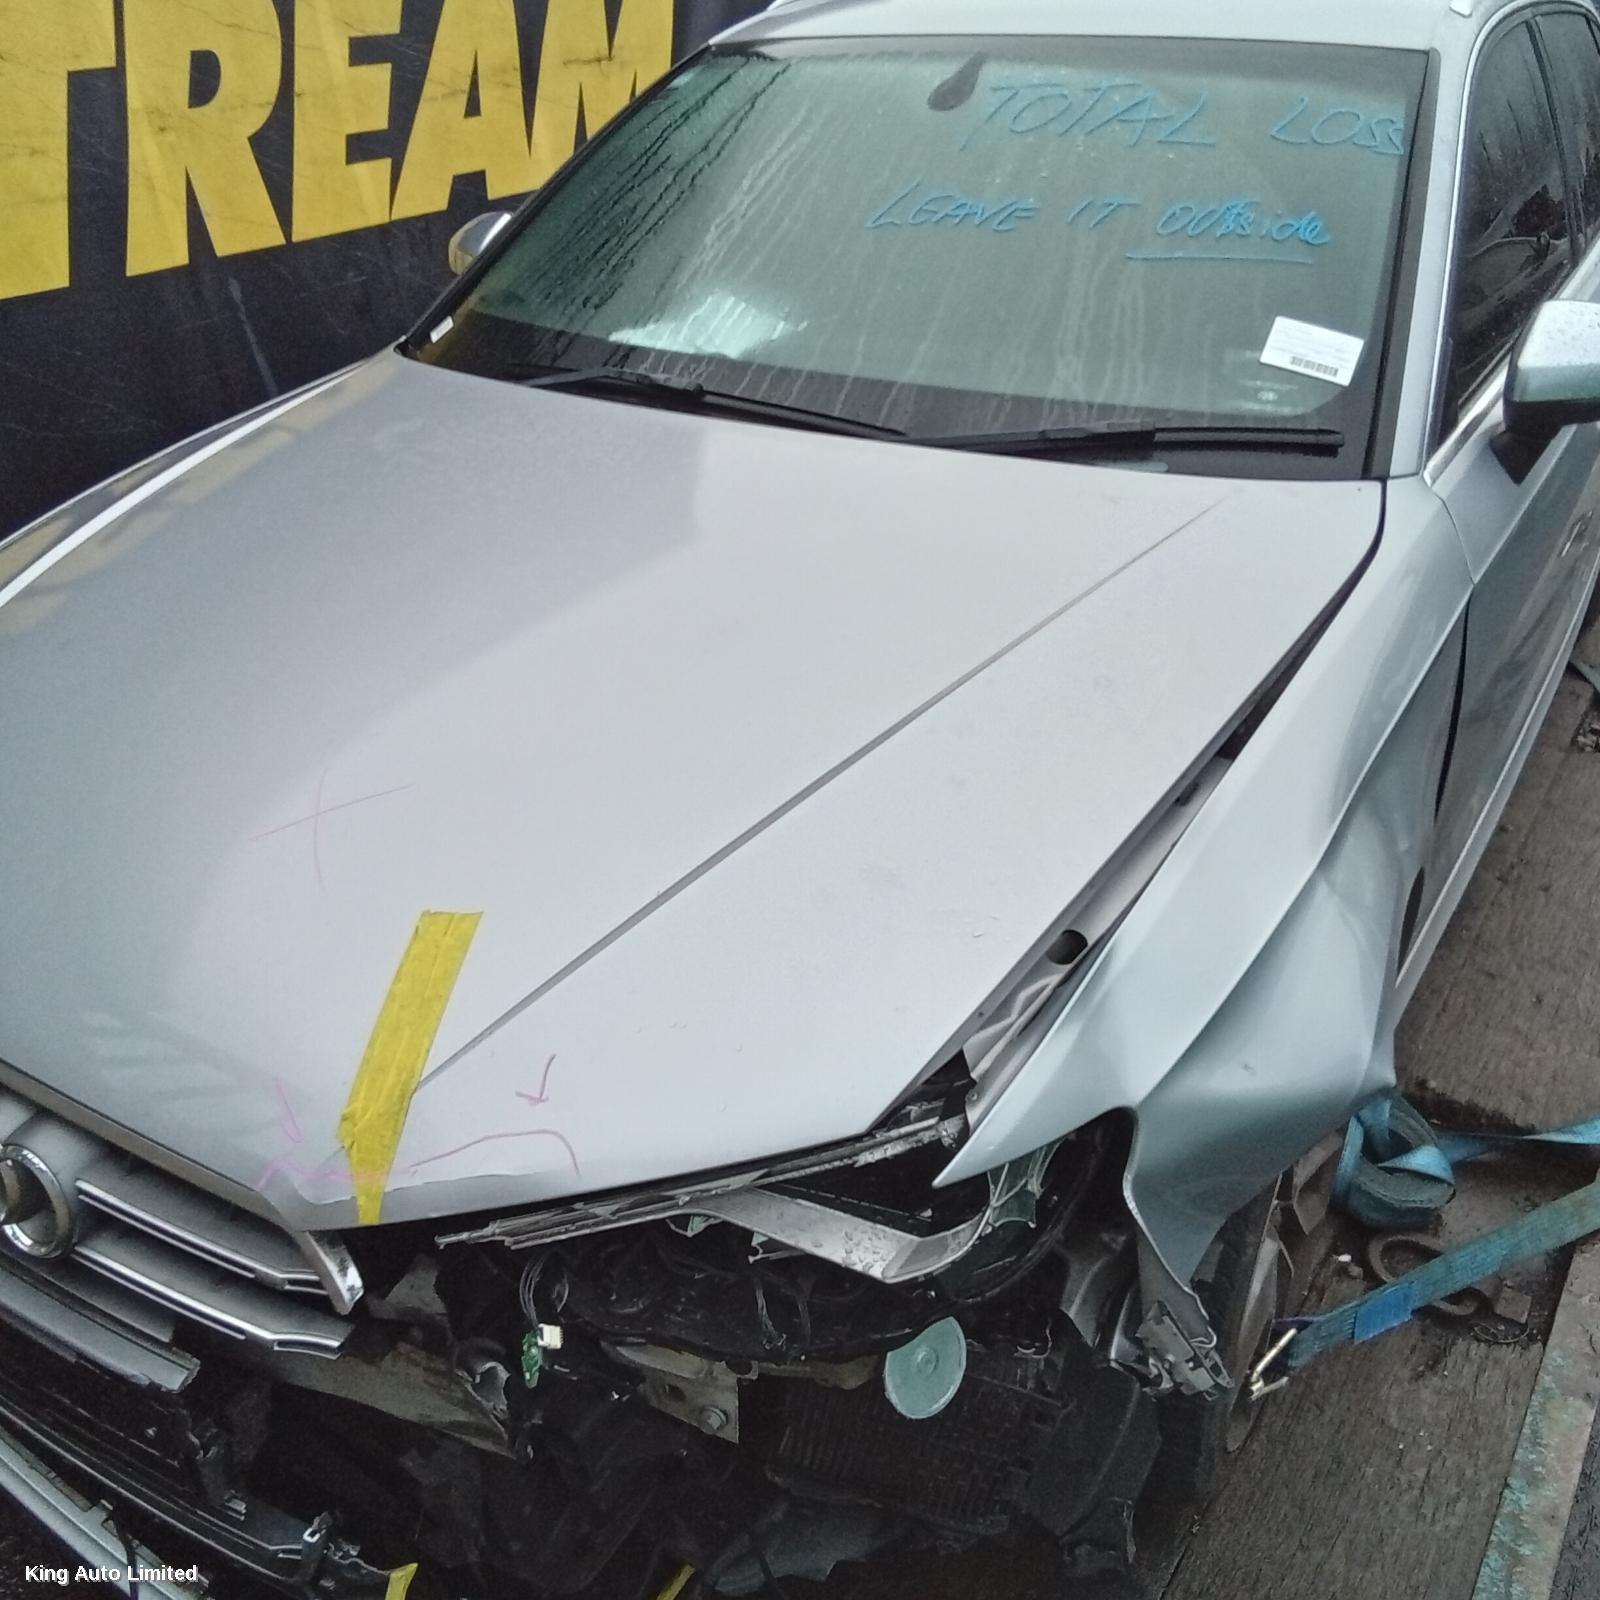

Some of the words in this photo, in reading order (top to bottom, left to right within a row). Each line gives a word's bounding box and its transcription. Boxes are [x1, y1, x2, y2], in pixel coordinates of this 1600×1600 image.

[958, 82, 1216, 151] TOTAL
[1270, 97, 1404, 155] LOSS
[864, 177, 1040, 232] LEAVE
[1066, 199, 1142, 229] IT
